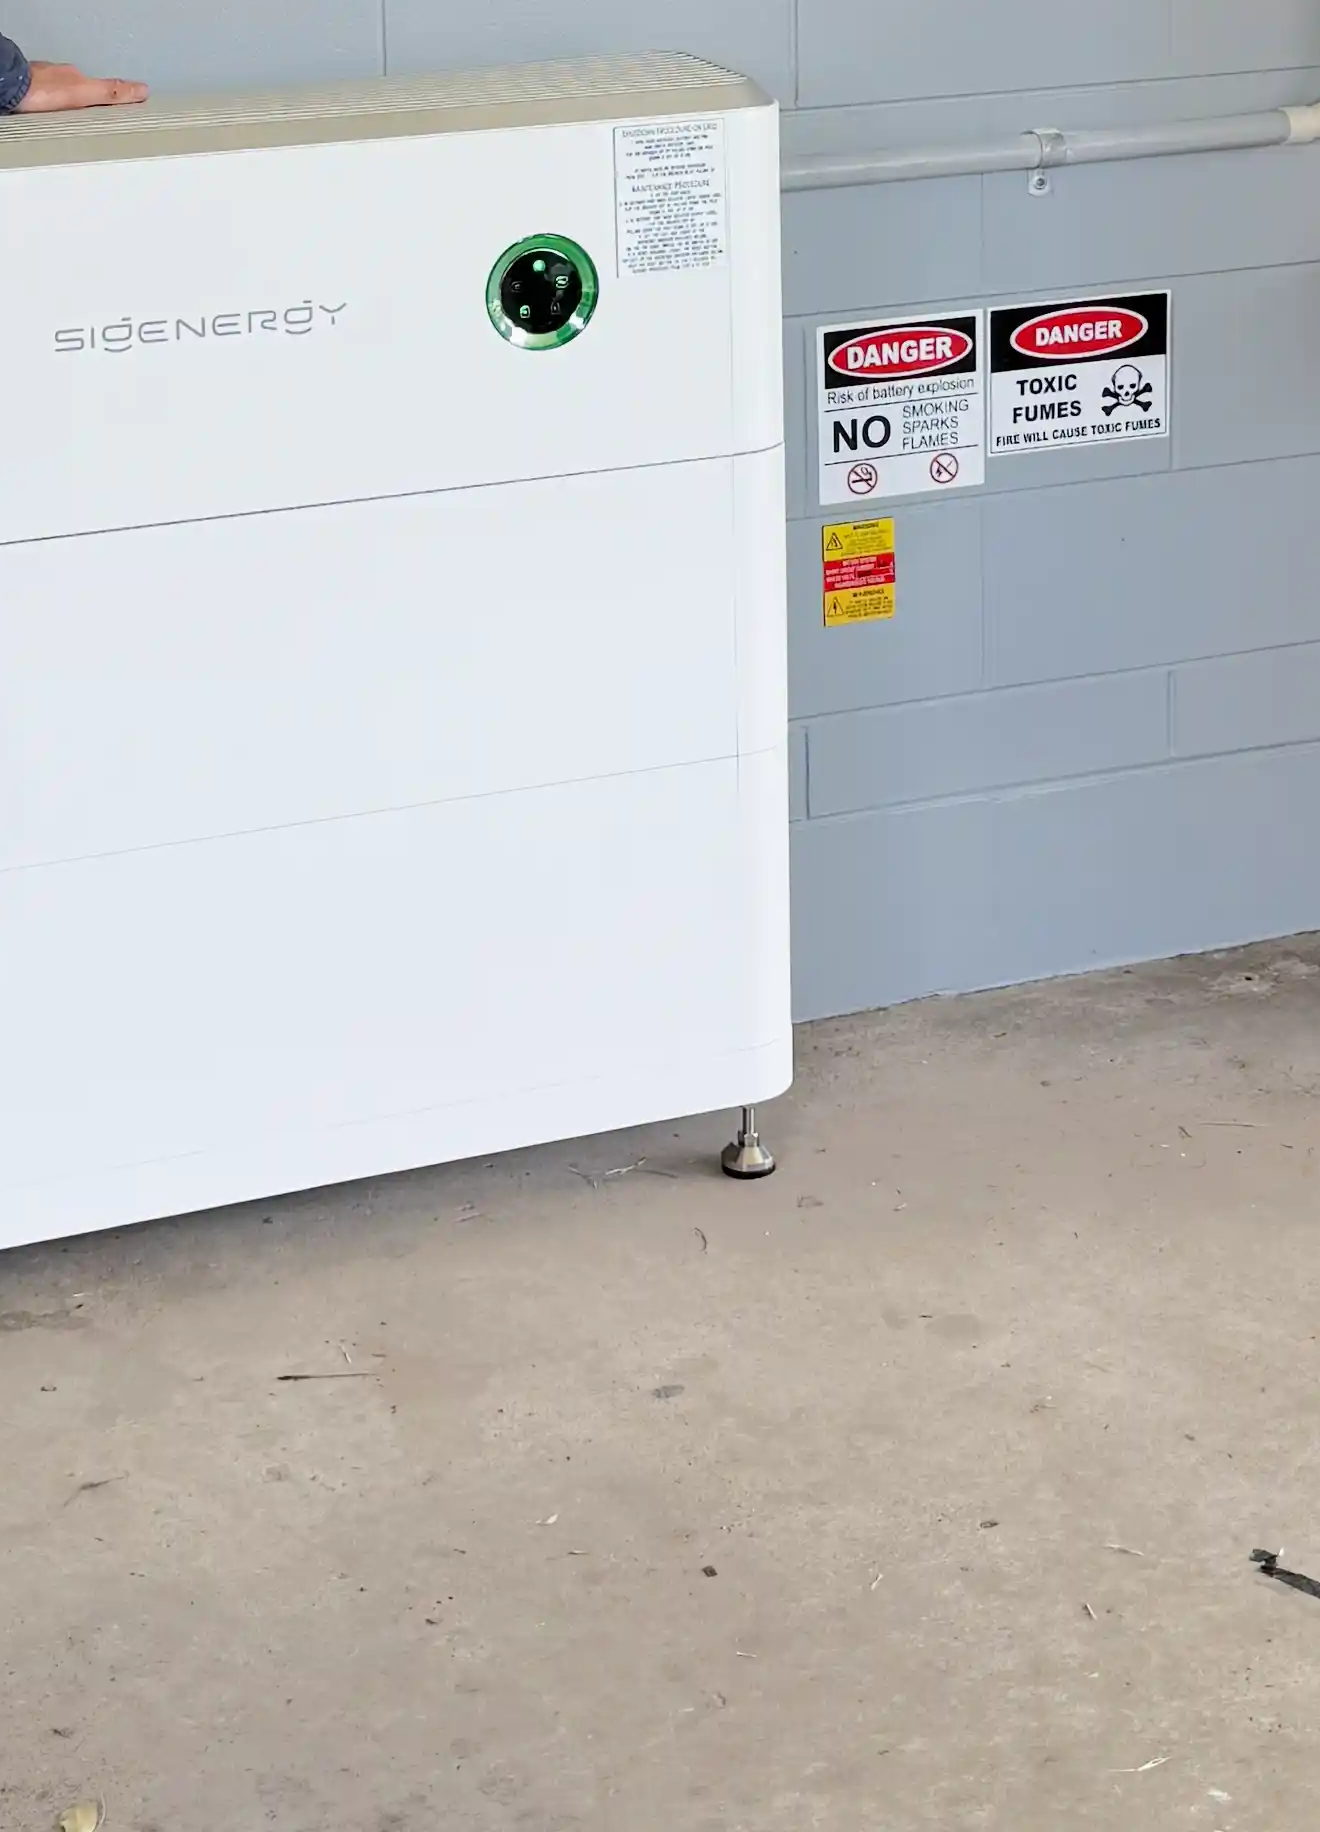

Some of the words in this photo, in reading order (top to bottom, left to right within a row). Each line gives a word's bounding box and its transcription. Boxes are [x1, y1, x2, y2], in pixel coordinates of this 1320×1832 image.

[1035, 320, 1123, 347] DANGER
[846, 336, 953, 370] DANGER
[827, 391, 854, 404] Risk
[857, 387, 870, 401] of
[872, 382, 914, 401] battery
[918, 378, 975, 395] explosion
[1016, 374, 1077, 396] TOXIC
[902, 399, 969, 419] SMOKING
[1012, 400, 1082, 424] FUMES
[833, 415, 891, 453] NO
[902, 416, 959, 435] SPARKS
[996, 434, 1020, 447] FIRE
[1023, 430, 1049, 443] WILL
[1052, 426, 1088, 440] CAUSE
[1091, 422, 1122, 435] TOXIC
[1125, 418, 1161, 432] FUMES
[902, 432, 959, 450] FLAMES
